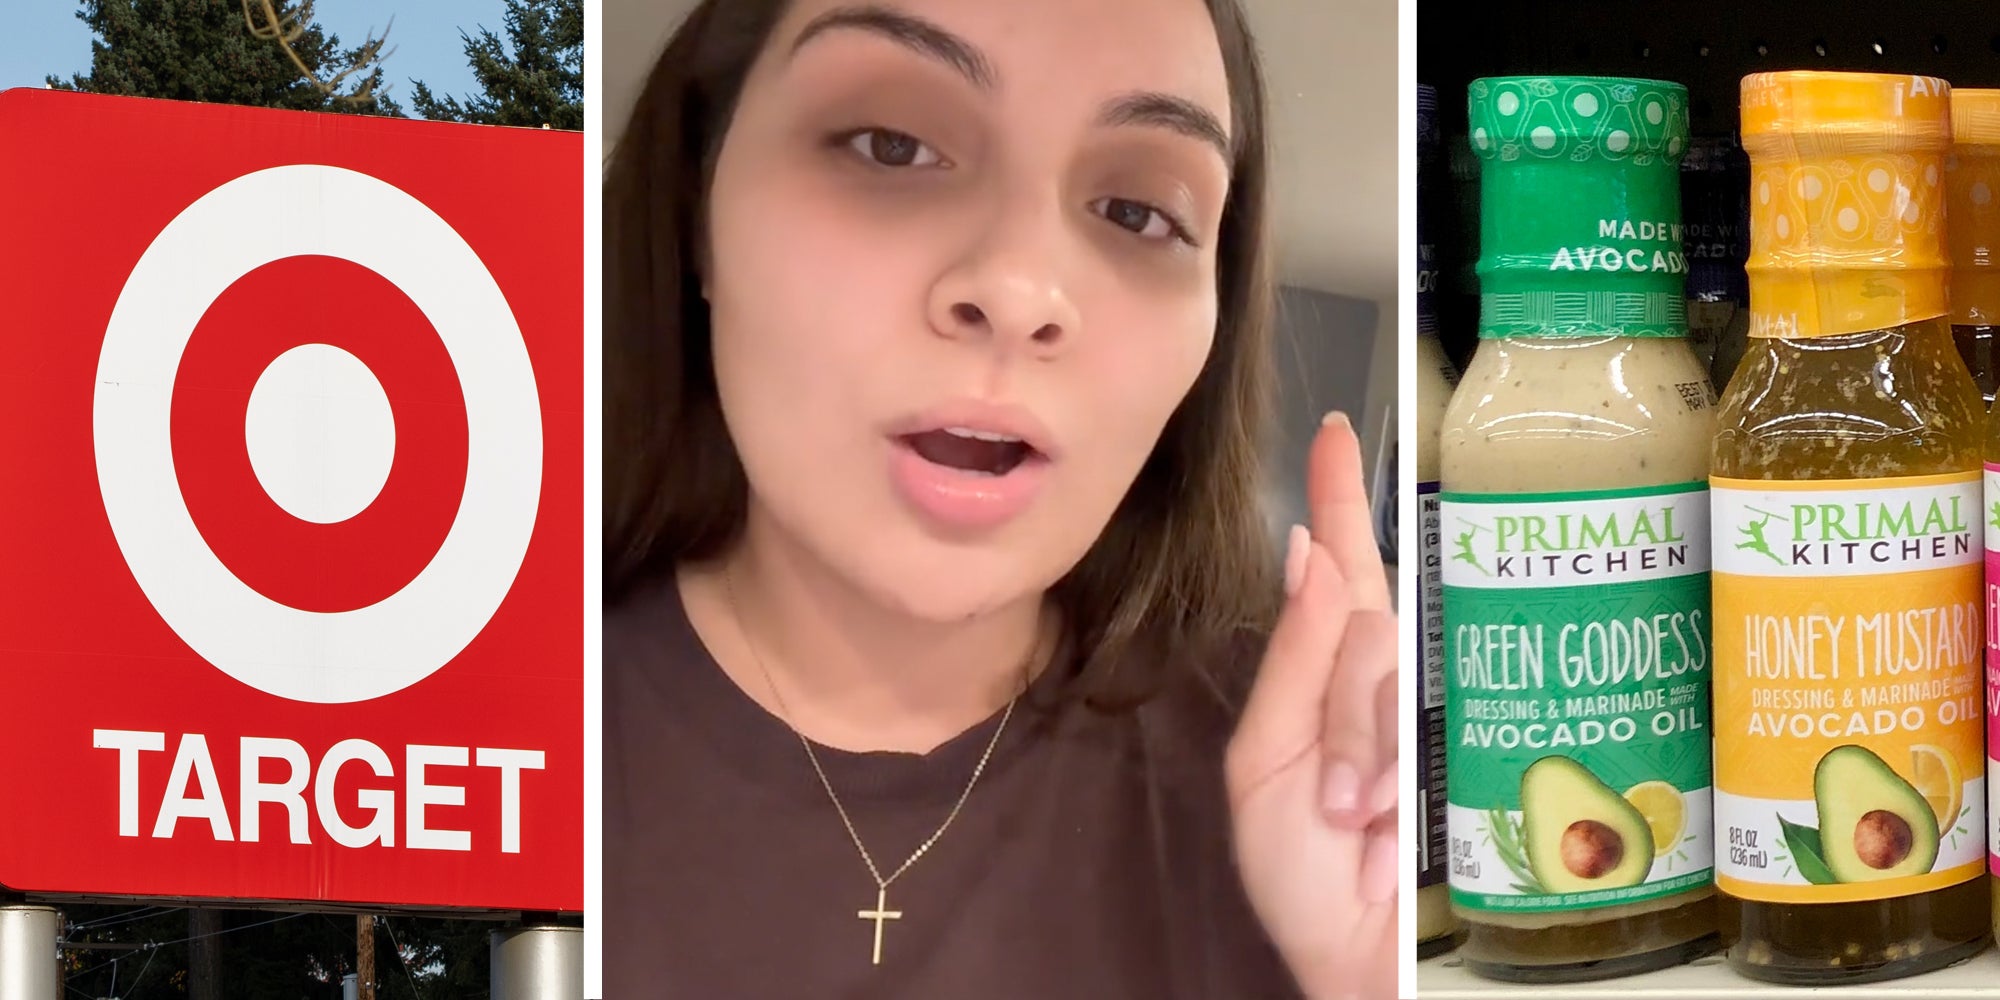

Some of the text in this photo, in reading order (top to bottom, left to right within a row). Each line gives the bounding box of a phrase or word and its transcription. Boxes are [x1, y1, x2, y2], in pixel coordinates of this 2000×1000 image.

[1600, 219, 1667, 241] MADE
[1494, 507, 1684, 552] PRIMAL
[1790, 496, 1968, 541] PRIMAL
[1497, 546, 1686, 577] KITCHEN
[1792, 533, 1970, 565] KITCHEN
[1457, 609, 1707, 690] GREEN GODDESS
[1745, 602, 1979, 680] HONEY MUSTARD
[1465, 688, 1666, 720] DRESSING & MARINADE
[1671, 683, 1699, 695] MADE
[1671, 693, 1696, 705] WITH
[1752, 678, 1950, 710] DRESSING & MARINADE
[1462, 706, 1703, 749] AVOCADO OIL
[1748, 706, 1925, 738] AVOCADO
[1937, 696, 1979, 725] OIL
[93, 728, 546, 853] TARGET
[1745, 829, 1759, 848] OZ
